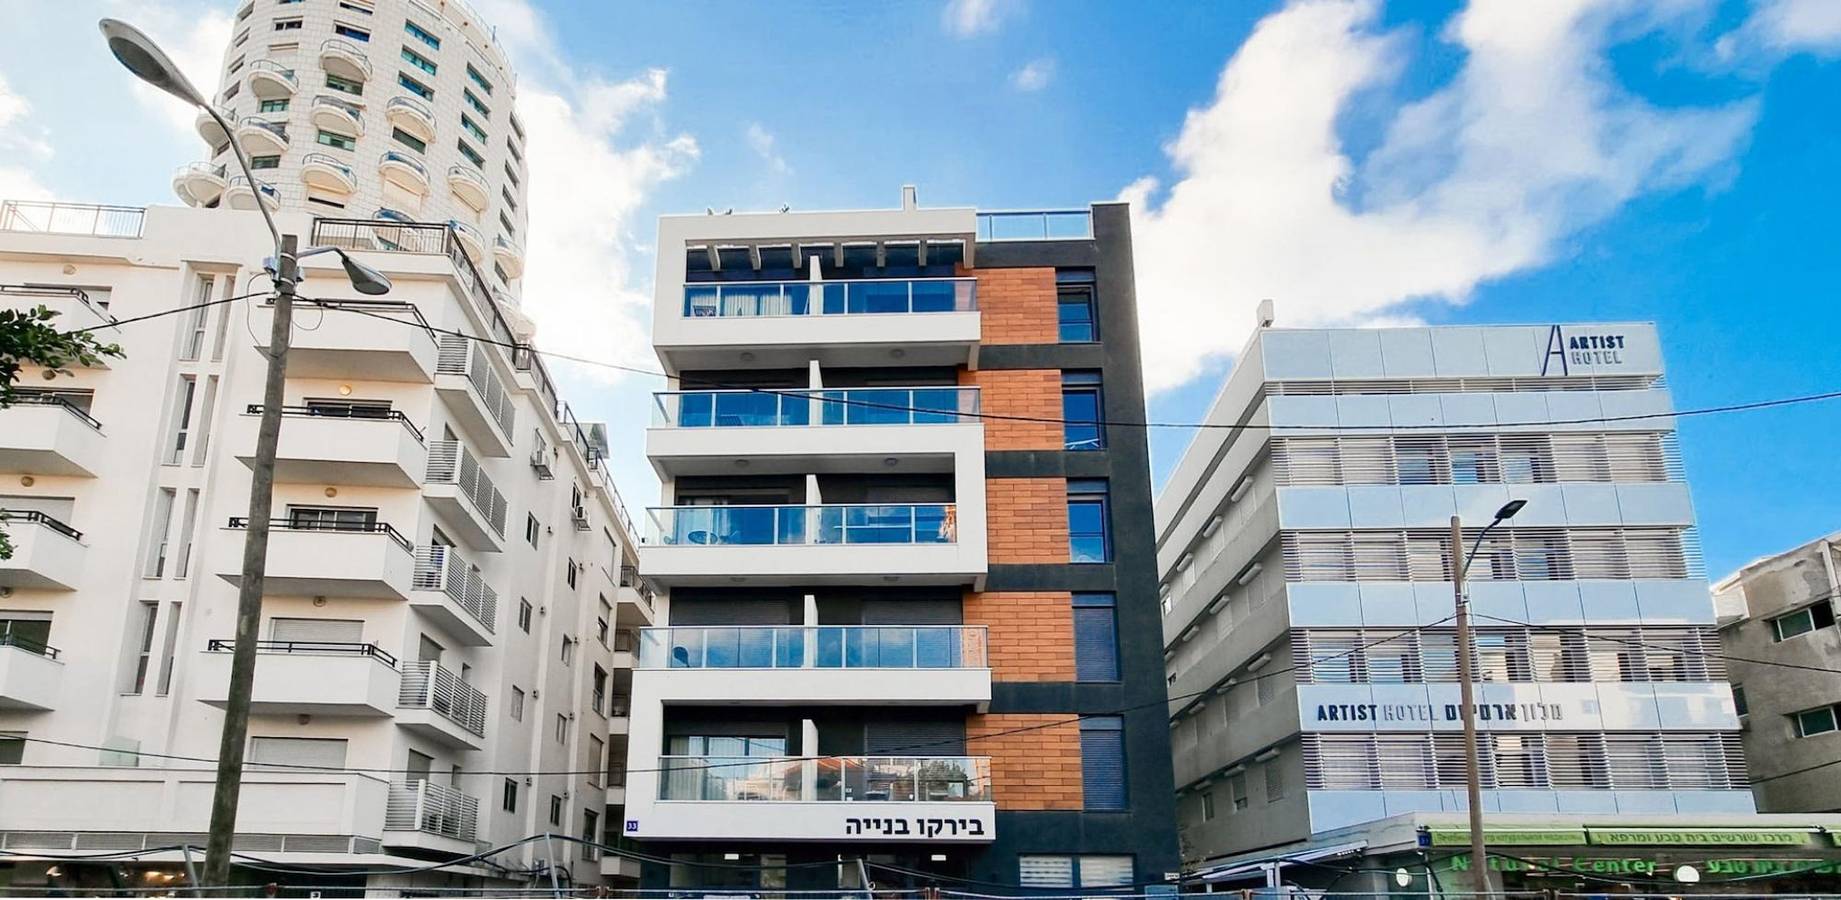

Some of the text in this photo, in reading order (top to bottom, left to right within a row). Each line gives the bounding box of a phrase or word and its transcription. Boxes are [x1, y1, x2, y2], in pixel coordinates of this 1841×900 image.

[1570, 335, 1624, 350] ARTIST
[1571, 350, 1622, 365] HOTEL
[1317, 704, 1439, 721] ARTIST HOTEL
[1521, 702, 1563, 722] מלון
[845, 818, 985, 838] בירקו בנייה
[1610, 833, 1651, 842] ומרפא
[1686, 833, 1708, 842] בית
[1572, 856, 1656, 873] Center
